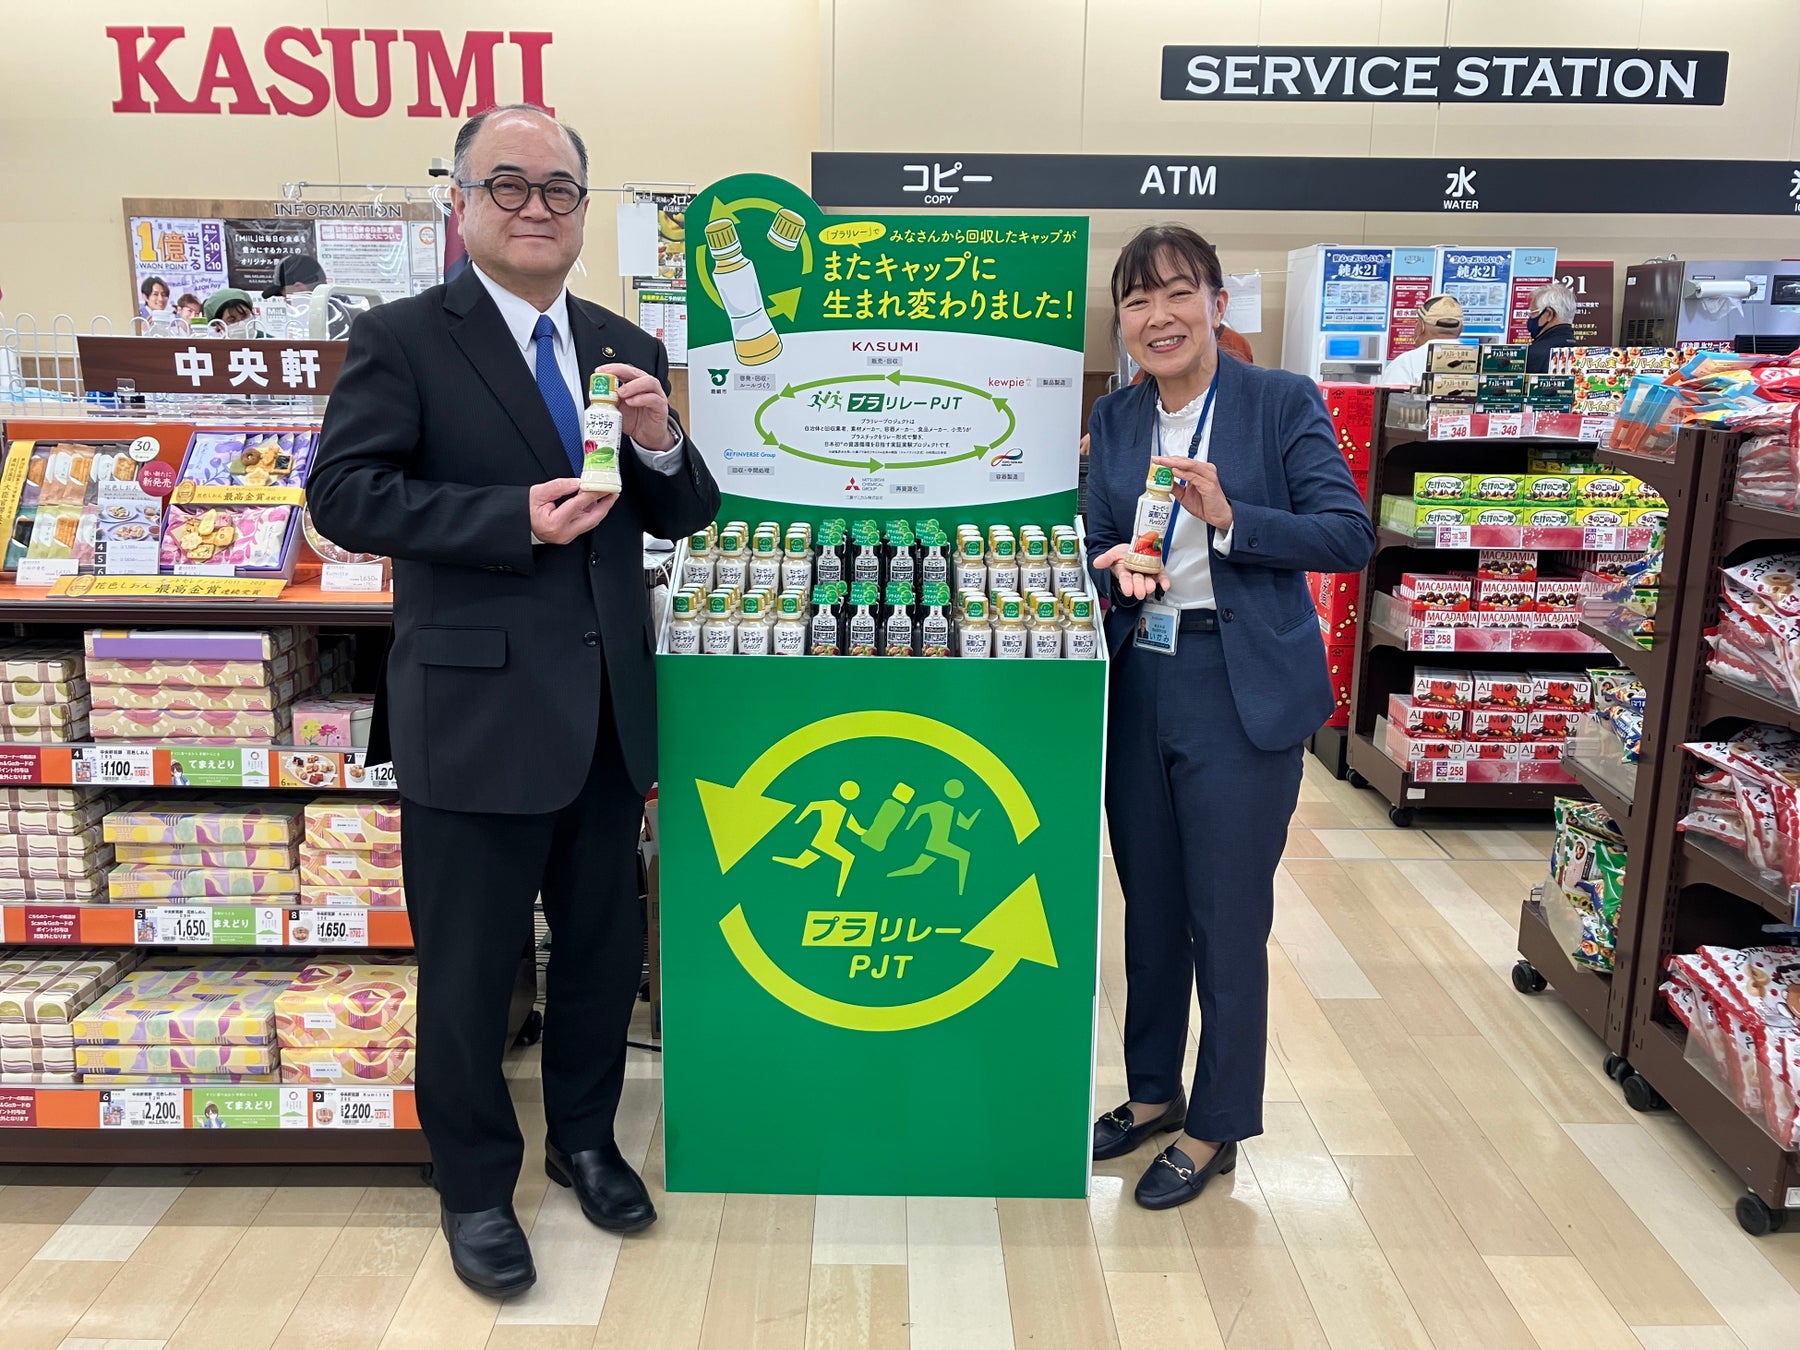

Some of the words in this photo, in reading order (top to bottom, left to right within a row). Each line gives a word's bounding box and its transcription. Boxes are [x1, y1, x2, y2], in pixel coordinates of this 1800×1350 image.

[105, 25, 556, 118] KASUMI
[1185, 54, 1440, 96] SERVICE
[1454, 56, 1698, 98] STATION
[902, 161, 993, 193] コピー
[1139, 165, 1217, 195] ATM
[1445, 165, 1477, 197] 水
[924, 195, 953, 204] COPY
[1443, 200, 1479, 210] WATER
[274, 203, 402, 218] INFORMATION
[824, 226, 881, 241] 「プラリレー」で
[889, 229, 1077, 244] みなさんから回収したキャップが
[187, 232, 201, 270] 当たる
[139, 262, 164, 270] WAON
[823, 250, 997, 282] またキャップに
[822, 288, 1074, 321] 生まれ変わりました!
[852, 341, 919, 352] KASUMI
[174, 346, 321, 389] 中央軒
[1580, 358, 1617, 369] パイの実
[1635, 358, 1672, 369] パイの実
[988, 377, 1025, 389] kewpie
[1451, 427, 1467, 438] 348
[1501, 425, 1518, 435] 348
[135, 441, 150, 451] 30
[760, 451, 776, 459] Group
[142, 477, 172, 489] 新発売
[1428, 481, 1462, 490] たけのこの里
[1481, 482, 1516, 491] たけのこの里
[1534, 482, 1569, 492] たけのこの里
[1590, 483, 1620, 492] きのこの山
[224, 492, 265, 501] 最高金賞
[1428, 514, 1461, 523] たけのこの里
[1480, 515, 1515, 523] たけのこの里
[1533, 515, 1567, 524] たけのこの里
[1588, 515, 1618, 524] きのこの山
[1481, 551, 1536, 561] MACADAMIA
[95, 582, 151, 590] 花色しおん
[155, 584, 223, 595] 最高金賞
[1417, 582, 1470, 591] MACADAMIA
[1483, 583, 1533, 592] MACADAMIA
[1539, 583, 1590, 592] MACADAMIA
[1427, 612, 1477, 622] MACADAMIA
[1481, 613, 1531, 622] MACADAMIA
[1437, 635, 1451, 644] 258
[73, 750, 80, 758] 4
[346, 754, 352, 762] 7
[189, 760, 235, 769] てまえどり
[374, 767, 394, 781] 1,20
[1450, 766, 1464, 776] 258
[291, 911, 297, 919] 8
[213, 919, 249, 928] まえどり
[806, 914, 962, 943] プラリレー
[848, 954, 914, 979] PJT
[315, 1092, 322, 1100] 9
[225, 1100, 273, 1110] てまえどり
[145, 1102, 176, 1120] 2,200
[344, 1103, 371, 1119] 2,200
